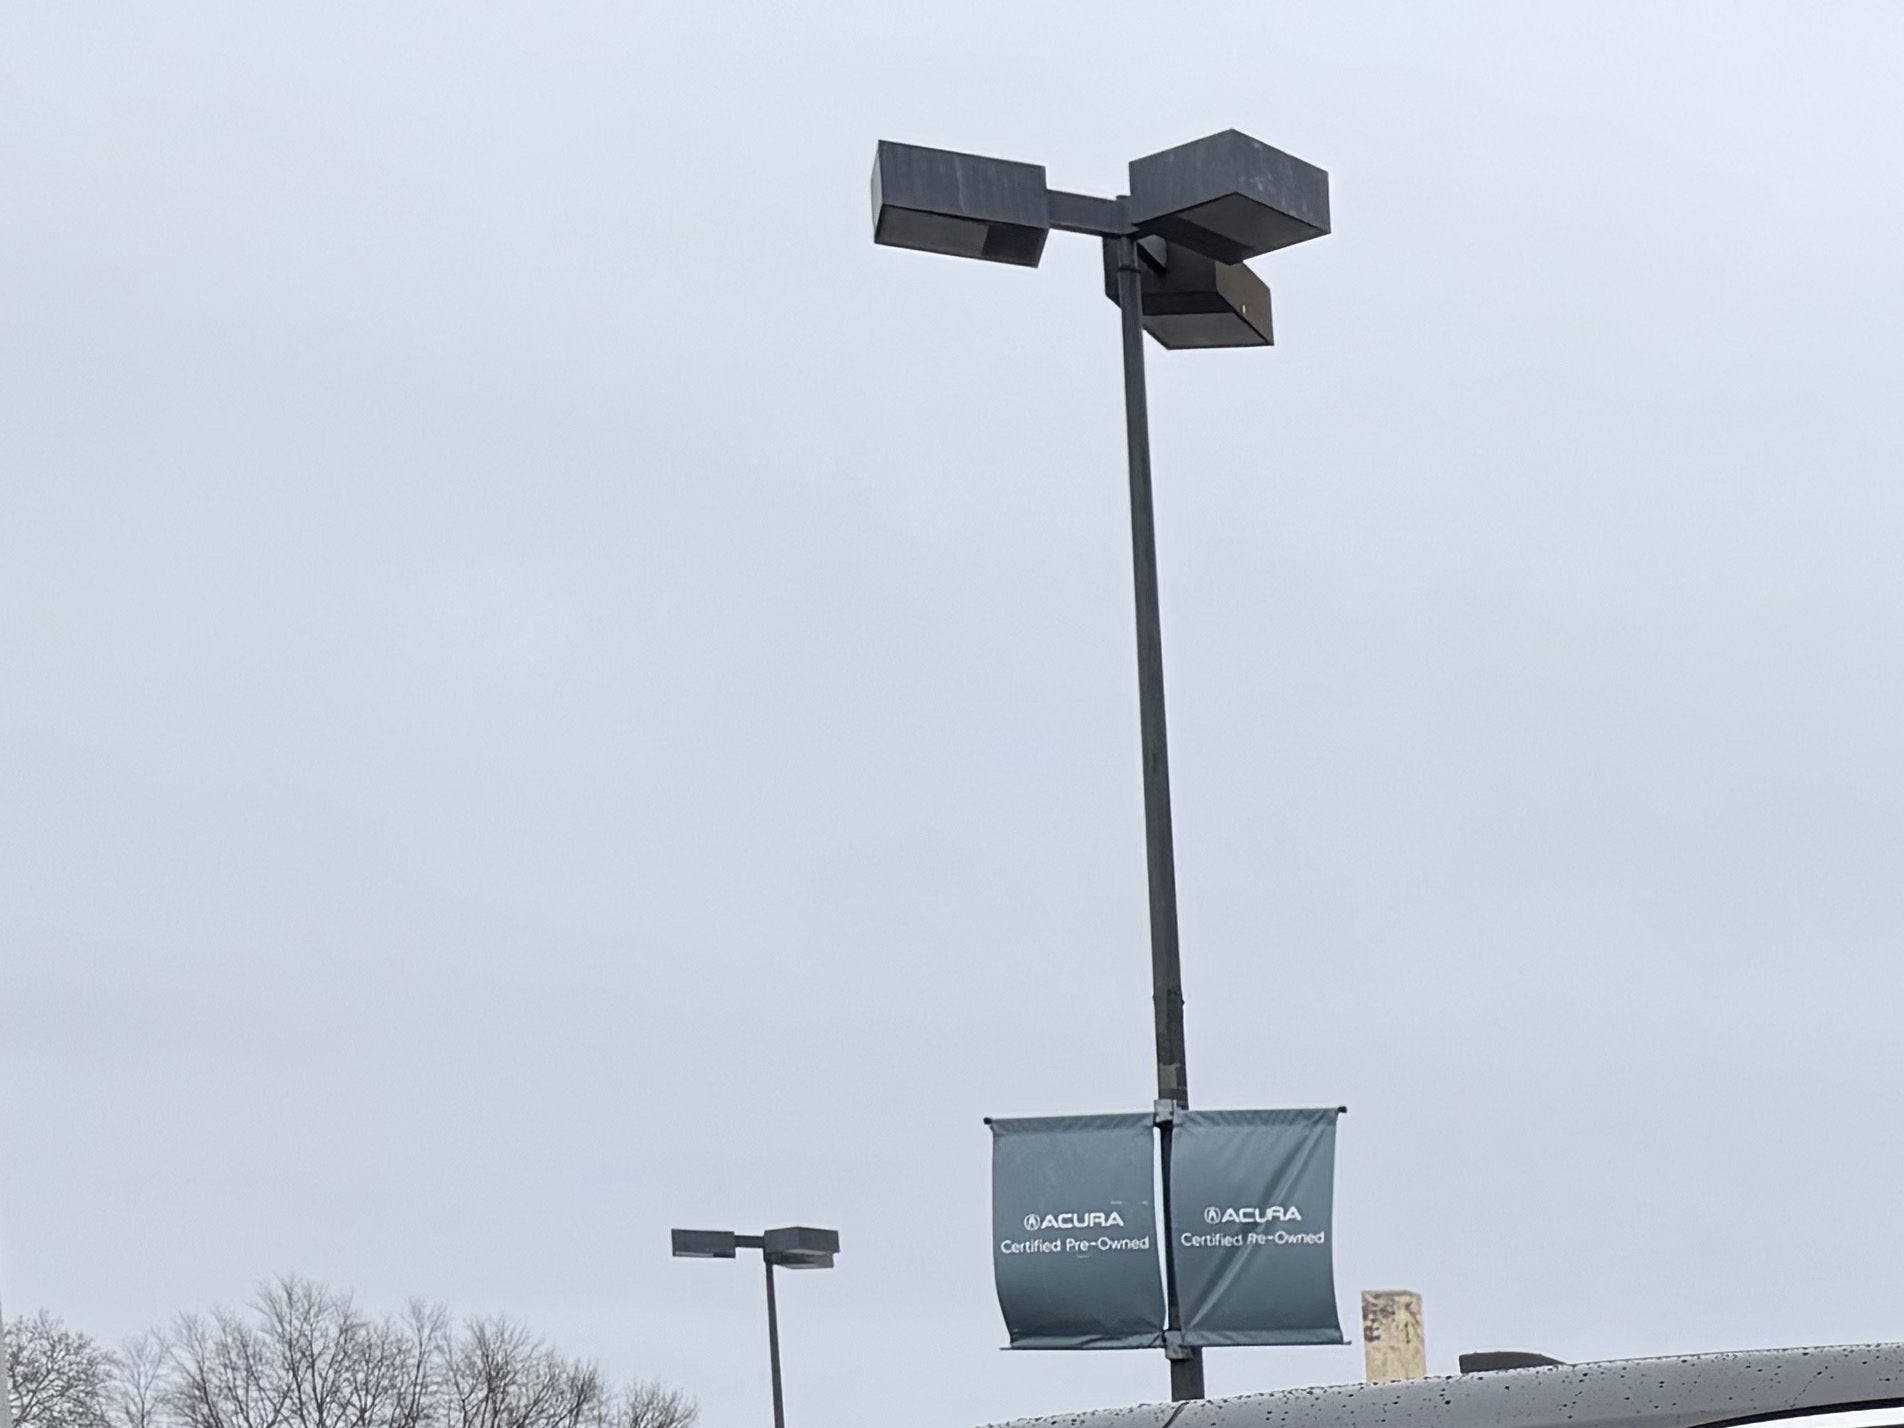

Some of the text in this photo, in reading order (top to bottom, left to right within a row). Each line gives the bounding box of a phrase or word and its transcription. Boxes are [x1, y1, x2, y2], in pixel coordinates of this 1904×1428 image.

[1040, 1211, 1124, 1230] ACURA
[1222, 1205, 1302, 1224] ACURA
[1000, 1235, 1150, 1254] Certified Pre-Owned
[1181, 1230, 1325, 1248] Certified Pre-Owned
